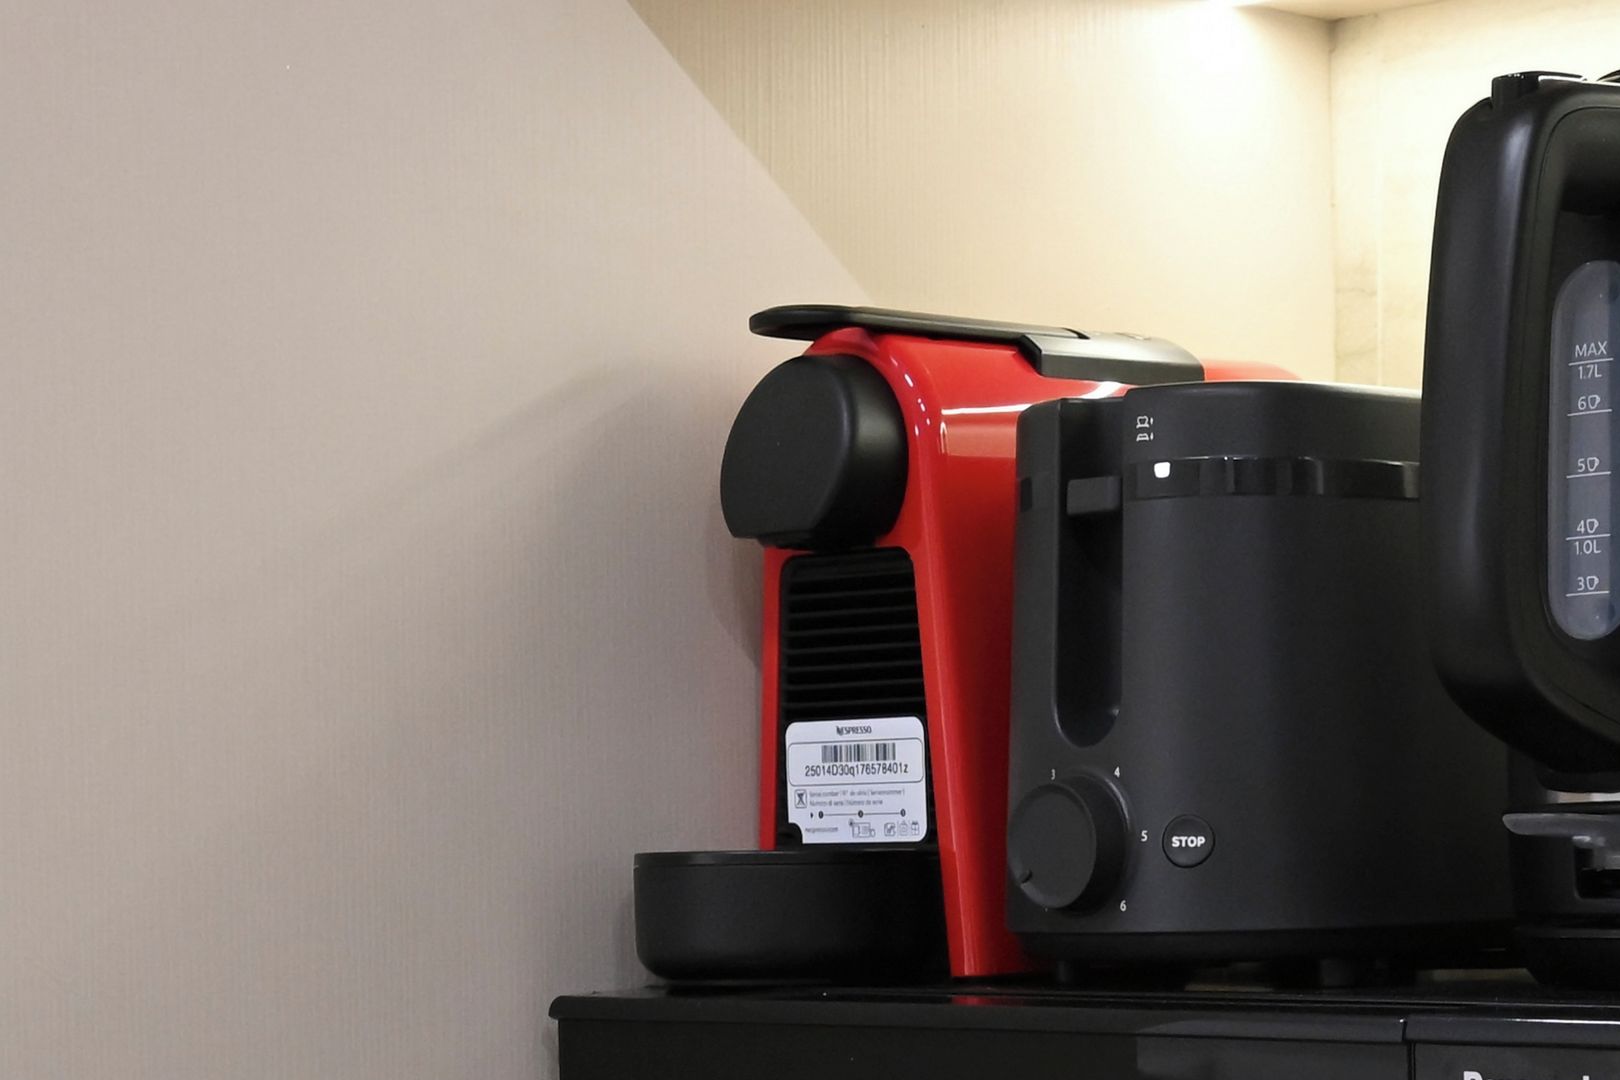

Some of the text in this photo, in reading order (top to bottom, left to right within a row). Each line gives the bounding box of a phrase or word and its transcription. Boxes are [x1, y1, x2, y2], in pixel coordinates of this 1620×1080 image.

[1575, 341, 1607, 358] MAX
[1578, 364, 1602, 380] 1.7L
[1578, 396, 1586, 410] 6
[1577, 458, 1586, 472] 5
[1576, 519, 1585, 534] 4
[1574, 540, 1601, 555] 1.0L
[1577, 576, 1585, 591] 3
[1051, 769, 1056, 780] 3
[1114, 767, 1120, 778] 4
[1141, 830, 1148, 841] 5
[1171, 836, 1206, 847] STOP
[1120, 900, 1127, 911] 6
